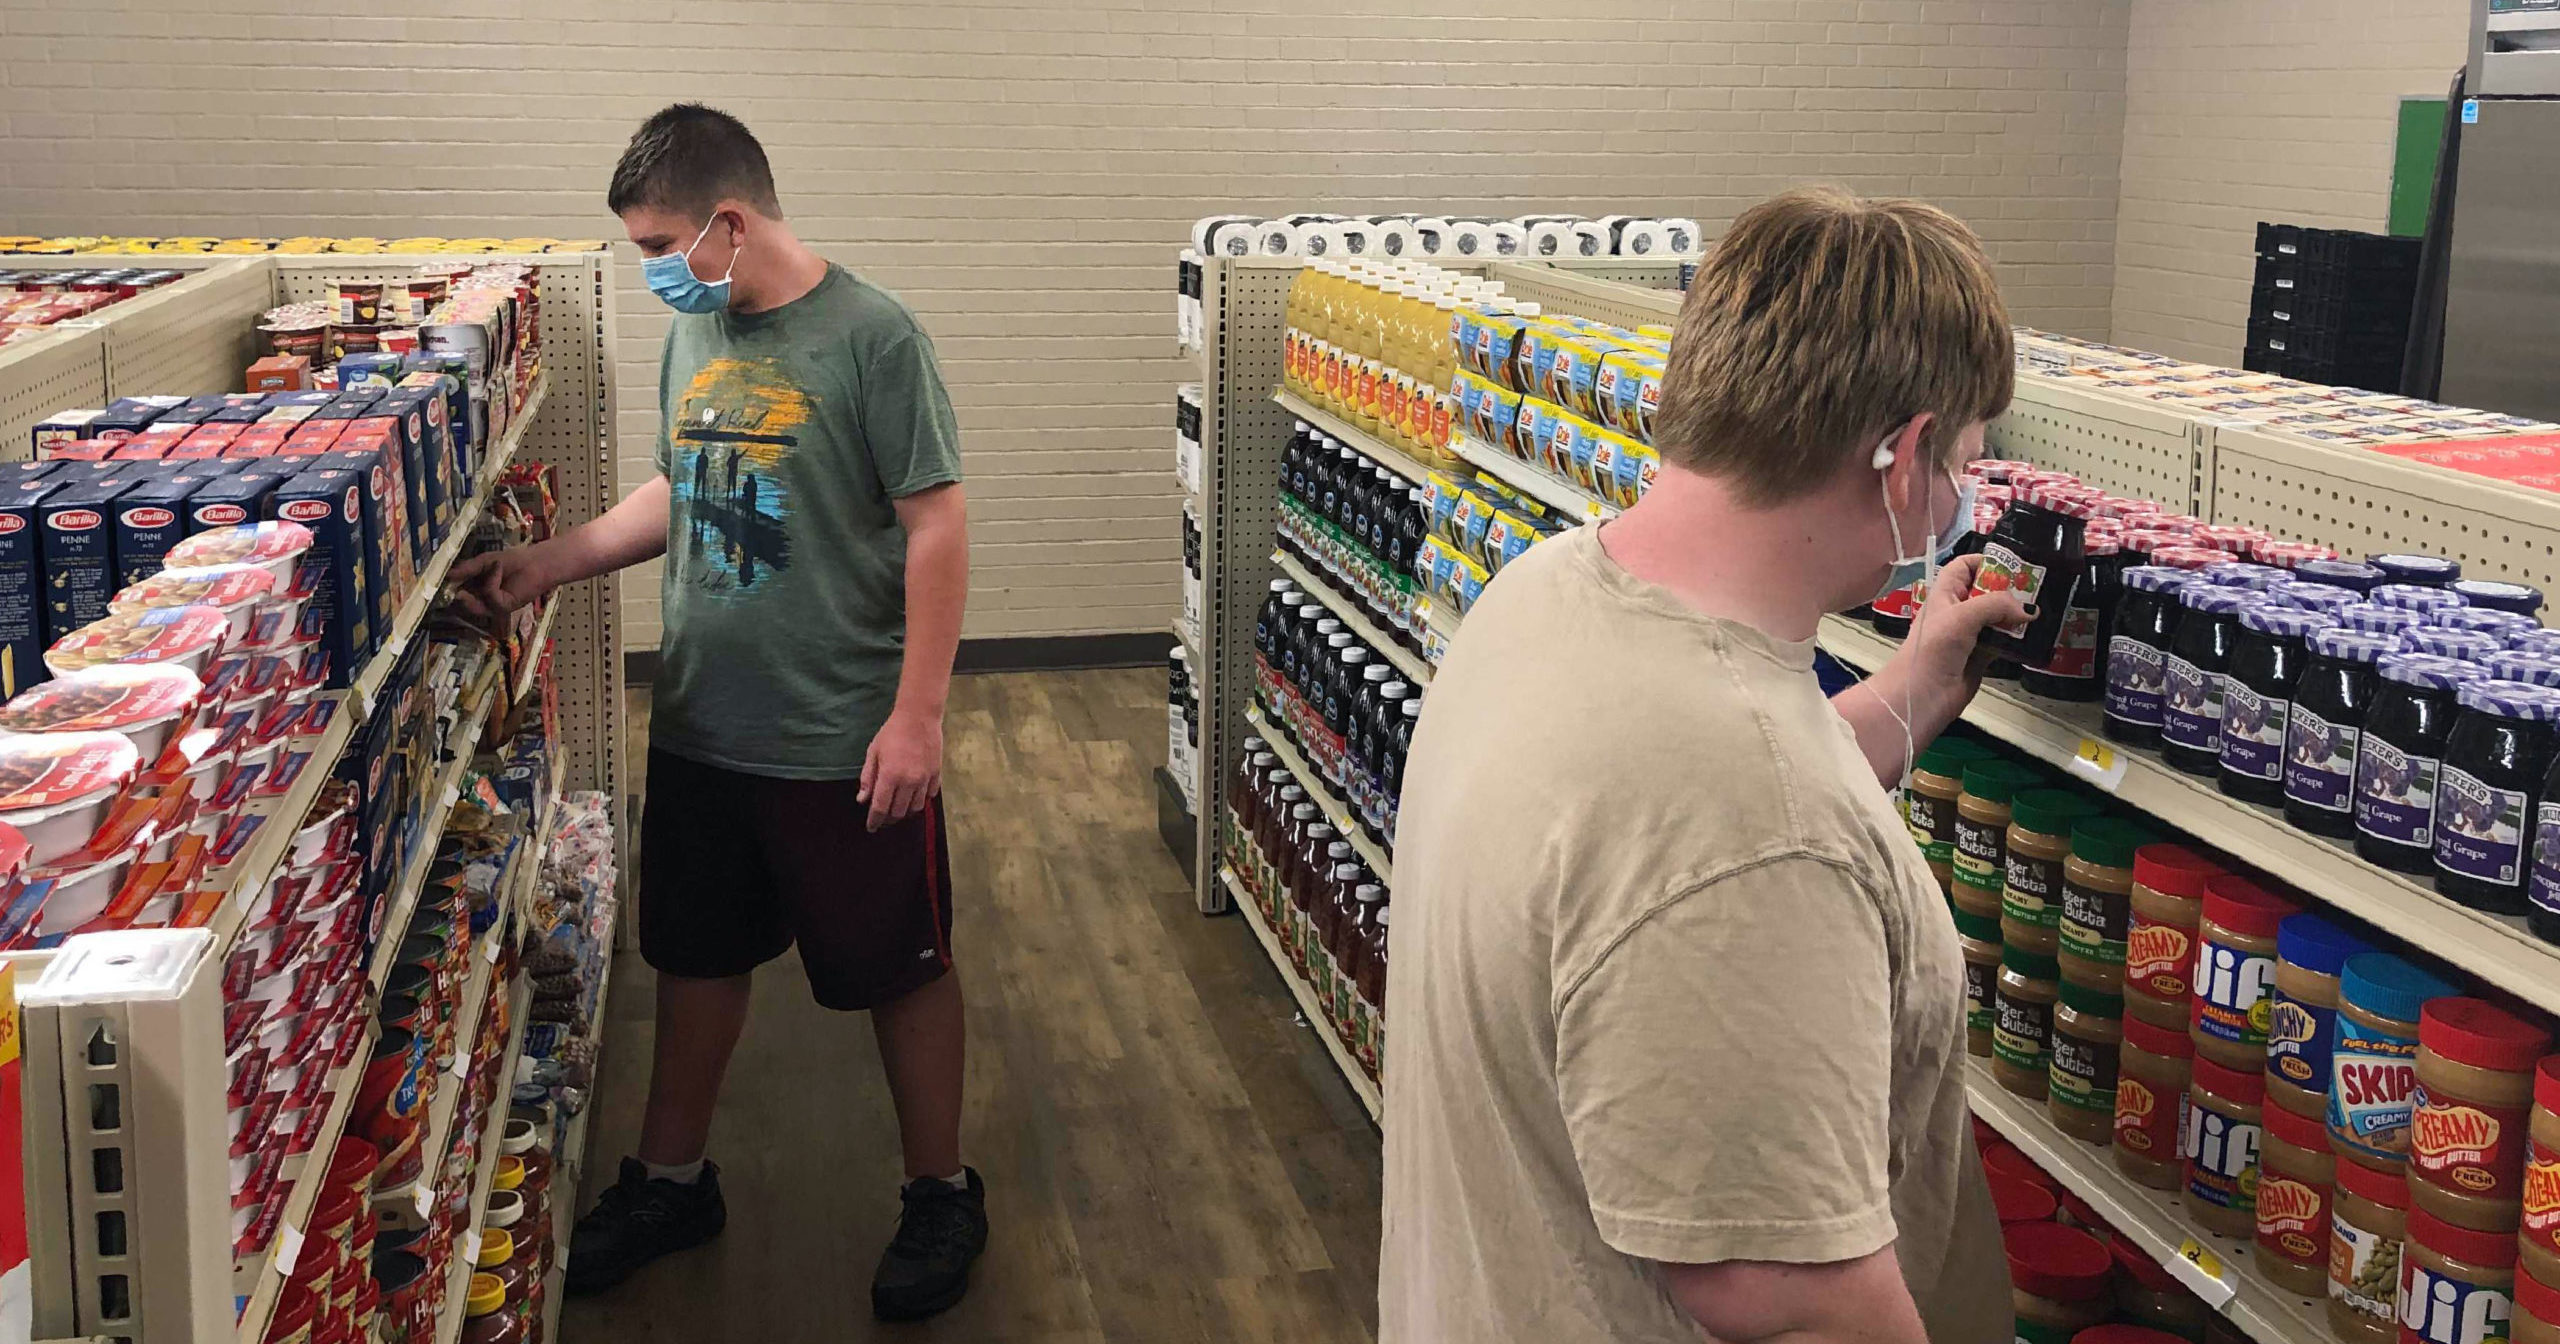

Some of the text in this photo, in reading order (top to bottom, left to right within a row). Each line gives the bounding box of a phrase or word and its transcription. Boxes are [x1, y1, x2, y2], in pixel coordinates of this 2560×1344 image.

[133, 510, 171, 523] Barilla
[205, 507, 244, 520] Barilla
[289, 502, 329, 516] Barilla
[59, 513, 97, 527] Barilla
[61, 535, 91, 544] PENNE
[133, 532, 163, 542] PENNE
[2129, 697, 2158, 711] Grape
[2172, 716, 2199, 732] Grape
[2230, 743, 2256, 760] Grape
[2296, 772, 2325, 790] Grape
[2441, 771, 2488, 802] CKER'S
[2371, 804, 2403, 824] Grape
[1960, 839, 1998, 858] Butta
[2453, 842, 2487, 861] Grape
[2007, 870, 2048, 894] Butta
[2064, 901, 2107, 928] Butta
[2153, 977, 2184, 991] FRESH
[2192, 940, 2277, 1011] Jif
[2001, 1013, 2043, 1039] Butta
[2342, 1037, 2370, 1050] FUEL
[2373, 1042, 2400, 1053] the
[2054, 1048, 2096, 1077] Butta
[2281, 1058, 2312, 1077] FRESH
[2340, 1062, 2416, 1107] SKIP
[2364, 1111, 2410, 1129] CREAMY
[2413, 1108, 2490, 1151] CREAMY
[2185, 1104, 2262, 1178] Jif
[2419, 1150, 2481, 1170] PEANUT BUTTER
[2454, 1169, 2493, 1187] FRESH
[2275, 1218, 2305, 1232] BUTTER
[2282, 1235, 2316, 1253] FRESH
[2399, 1264, 2514, 1344] Jif
